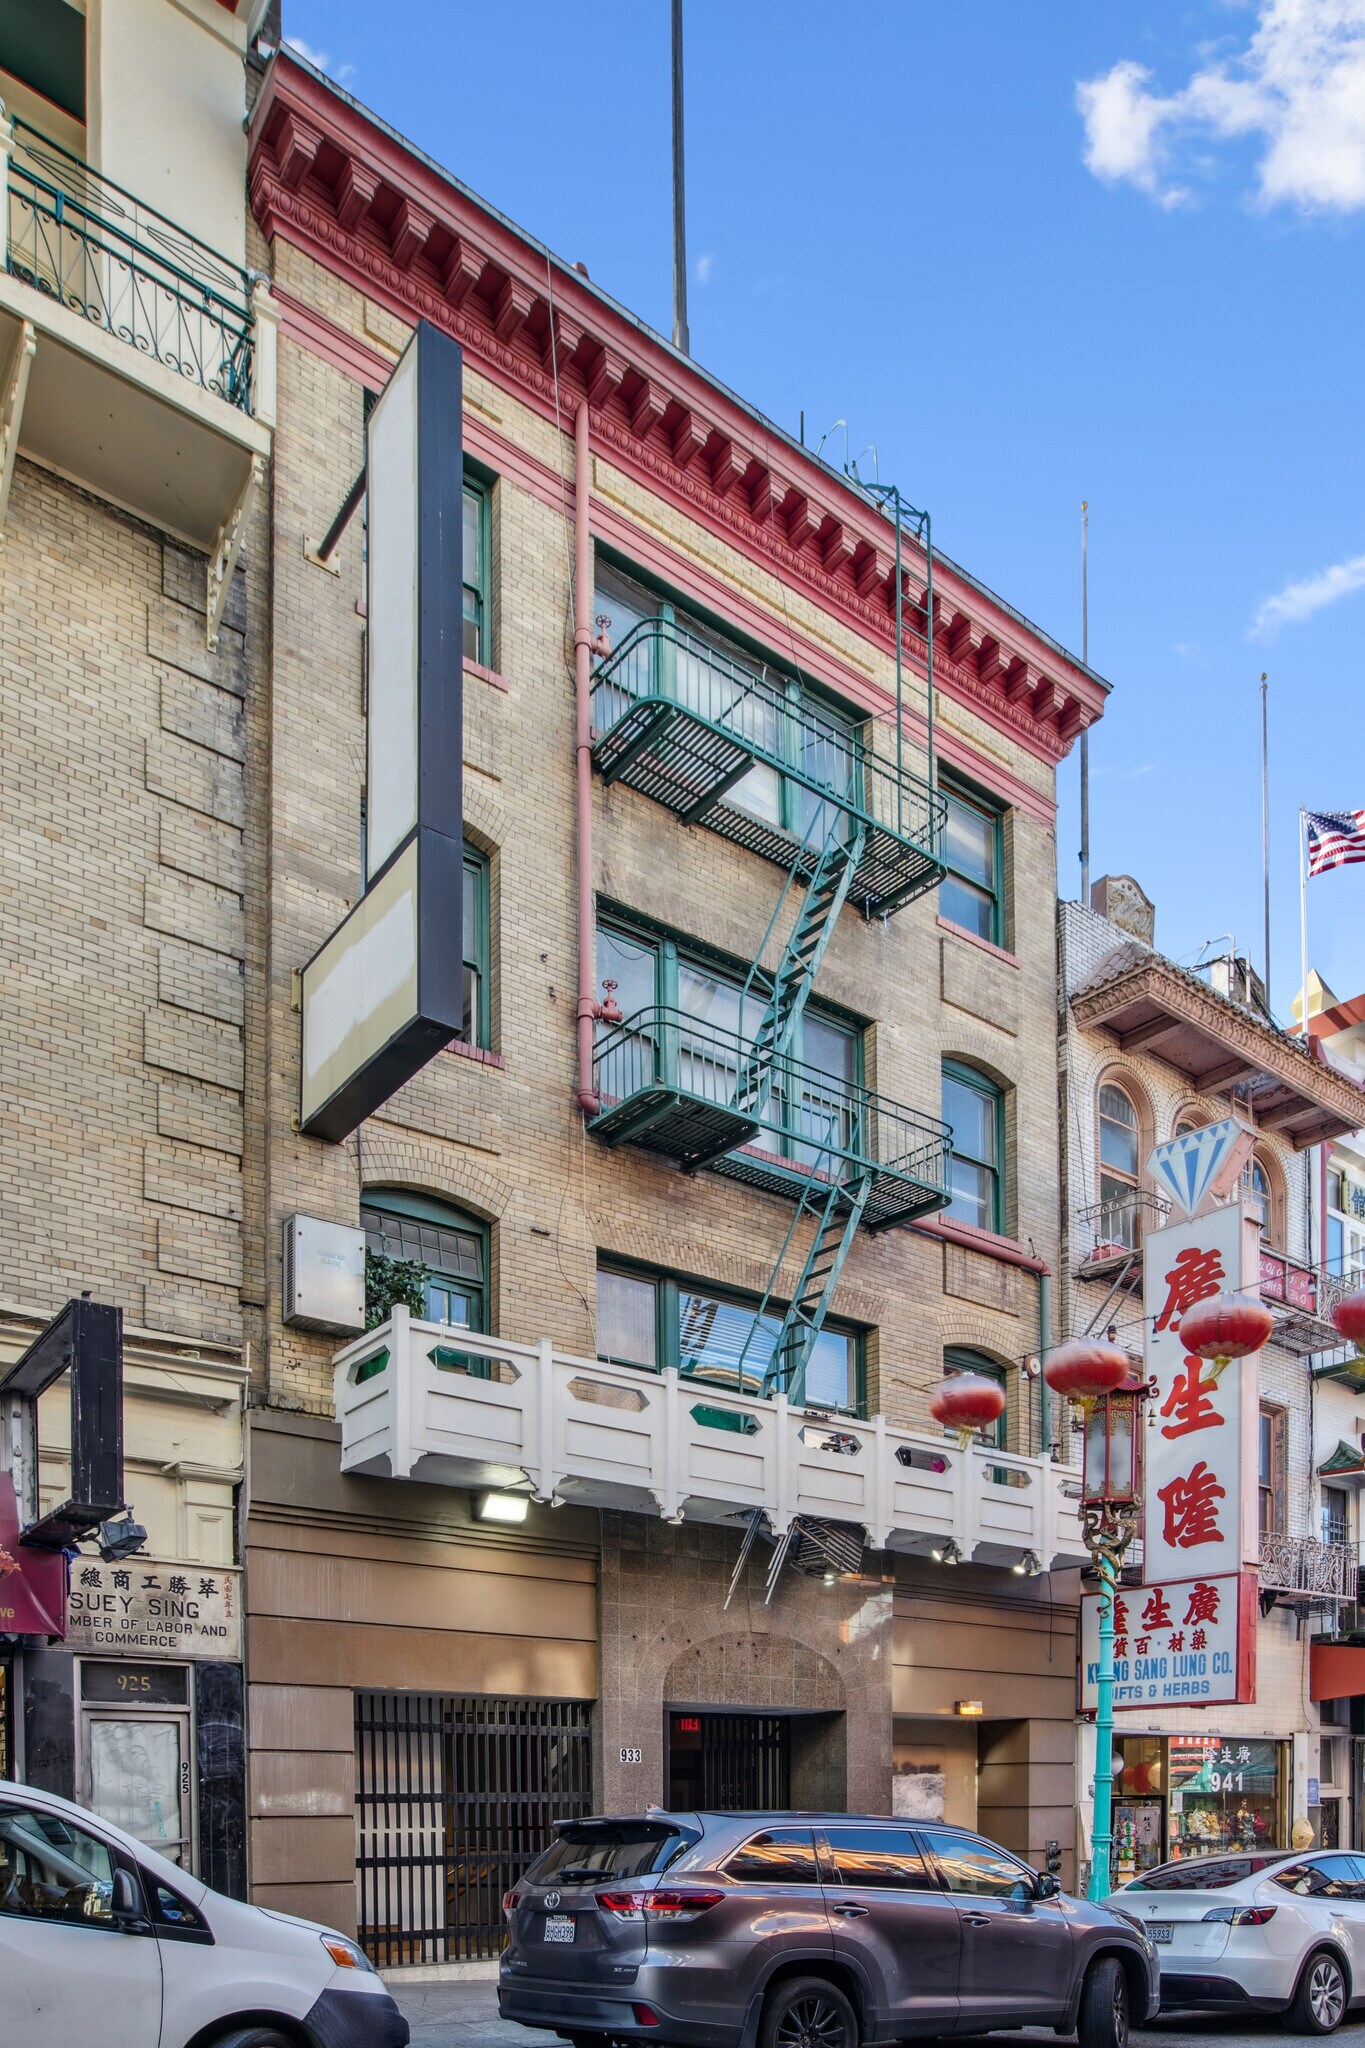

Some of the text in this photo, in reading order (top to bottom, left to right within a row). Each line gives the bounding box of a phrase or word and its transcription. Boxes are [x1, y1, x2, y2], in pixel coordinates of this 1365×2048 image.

[70, 1592, 199, 1619] SUEY SING
[121, 1618, 139, 1630] OF
[146, 1620, 193, 1634] LABOR
[201, 1625, 227, 1637] AND
[95, 1631, 177, 1647] COMMERCE
[1088, 1651, 1232, 1684] KNG SANG LUNG CO.
[117, 1675, 150, 1692] 925
[1112, 1680, 1210, 1700] IFTS & HERBS
[621, 1748, 641, 1762] 933
[181, 1762, 189, 1793] 925
[1210, 1772, 1243, 1792] 941
